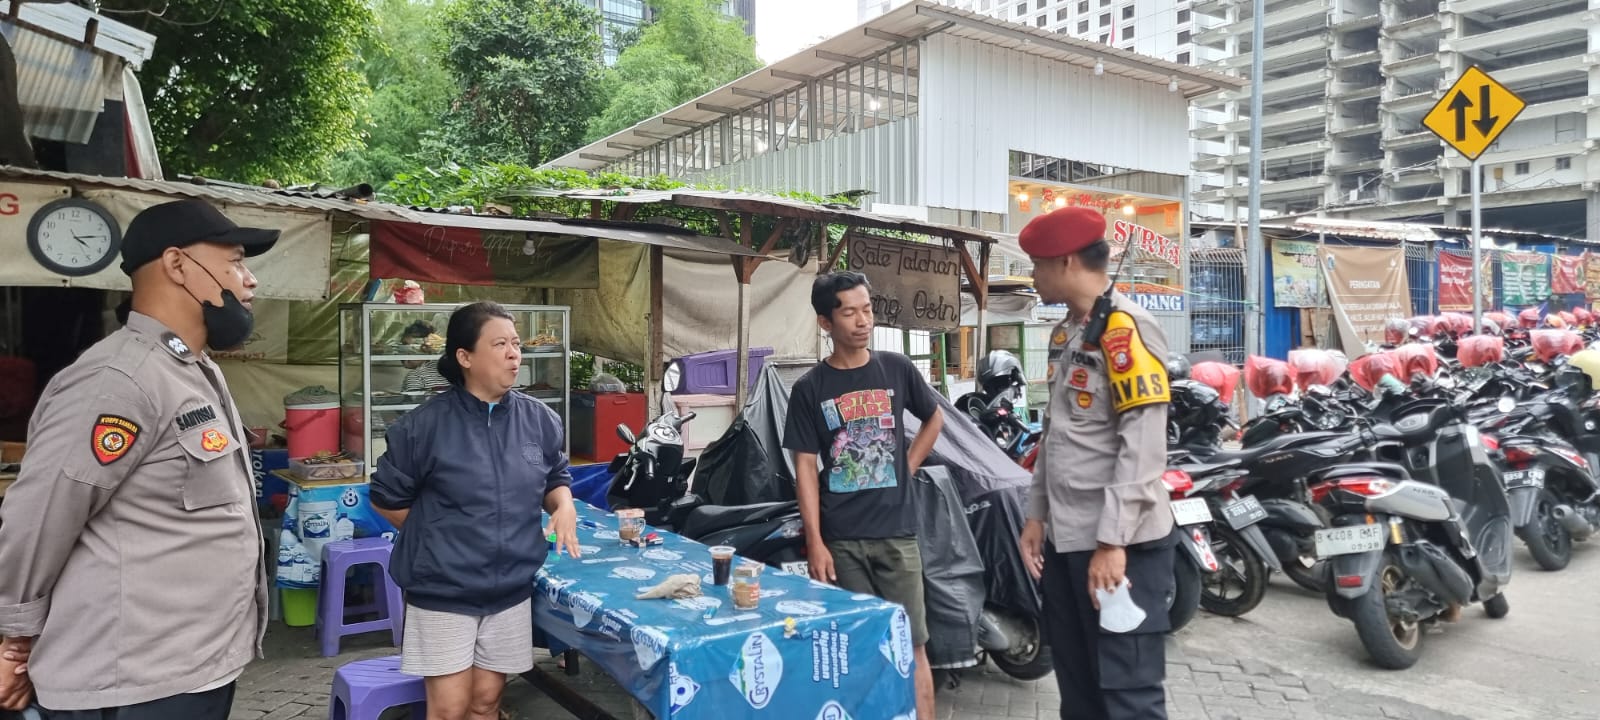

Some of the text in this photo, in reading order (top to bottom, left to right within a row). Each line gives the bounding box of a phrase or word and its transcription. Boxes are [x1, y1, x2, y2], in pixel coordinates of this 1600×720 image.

[1114, 219, 1181, 269] SURYA
[868, 294, 902, 326] ang
[1134, 294, 1182, 311] DANG
[840, 389, 889, 409] STAR
[841, 402, 892, 421] WARS
[748, 634, 769, 705] CRYSTALIN
